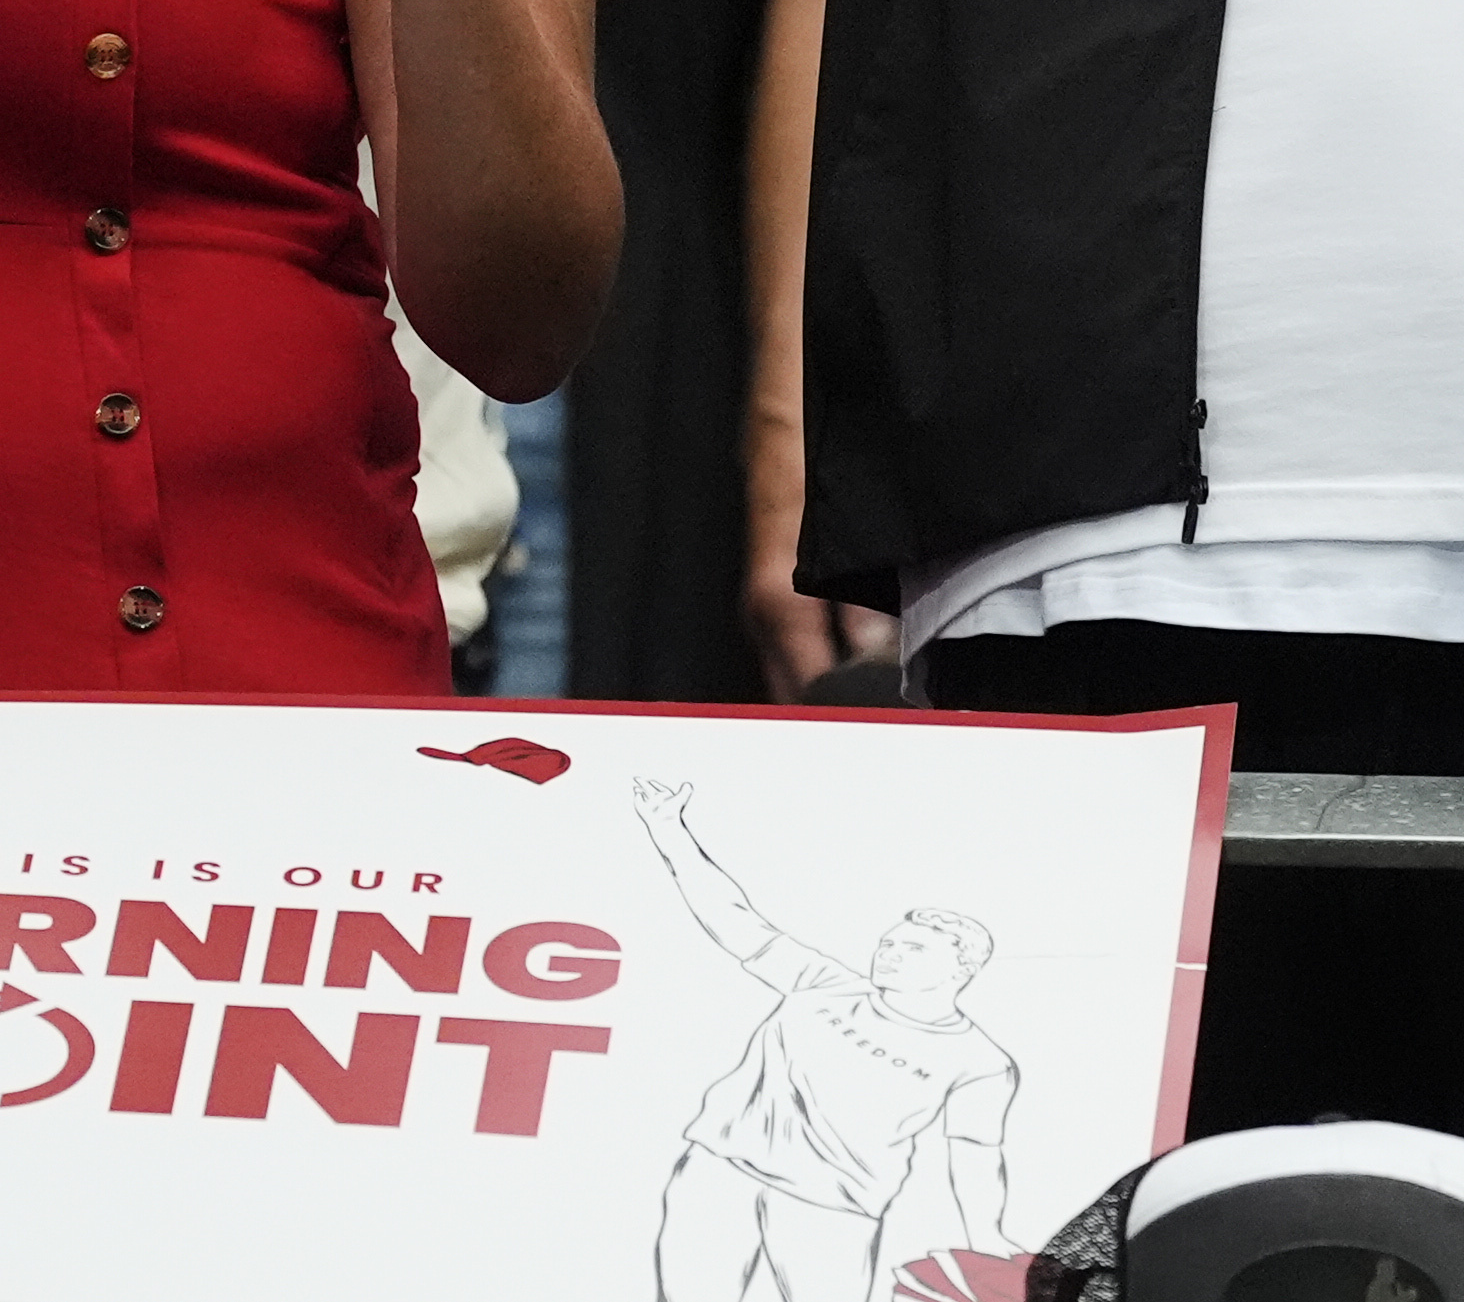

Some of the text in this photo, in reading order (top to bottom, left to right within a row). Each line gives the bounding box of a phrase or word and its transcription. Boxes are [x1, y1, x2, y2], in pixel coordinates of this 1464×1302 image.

[151, 859, 223, 883] IS
[282, 864, 445, 894] OUR
[816, 1007, 931, 1081] FREEDOM
